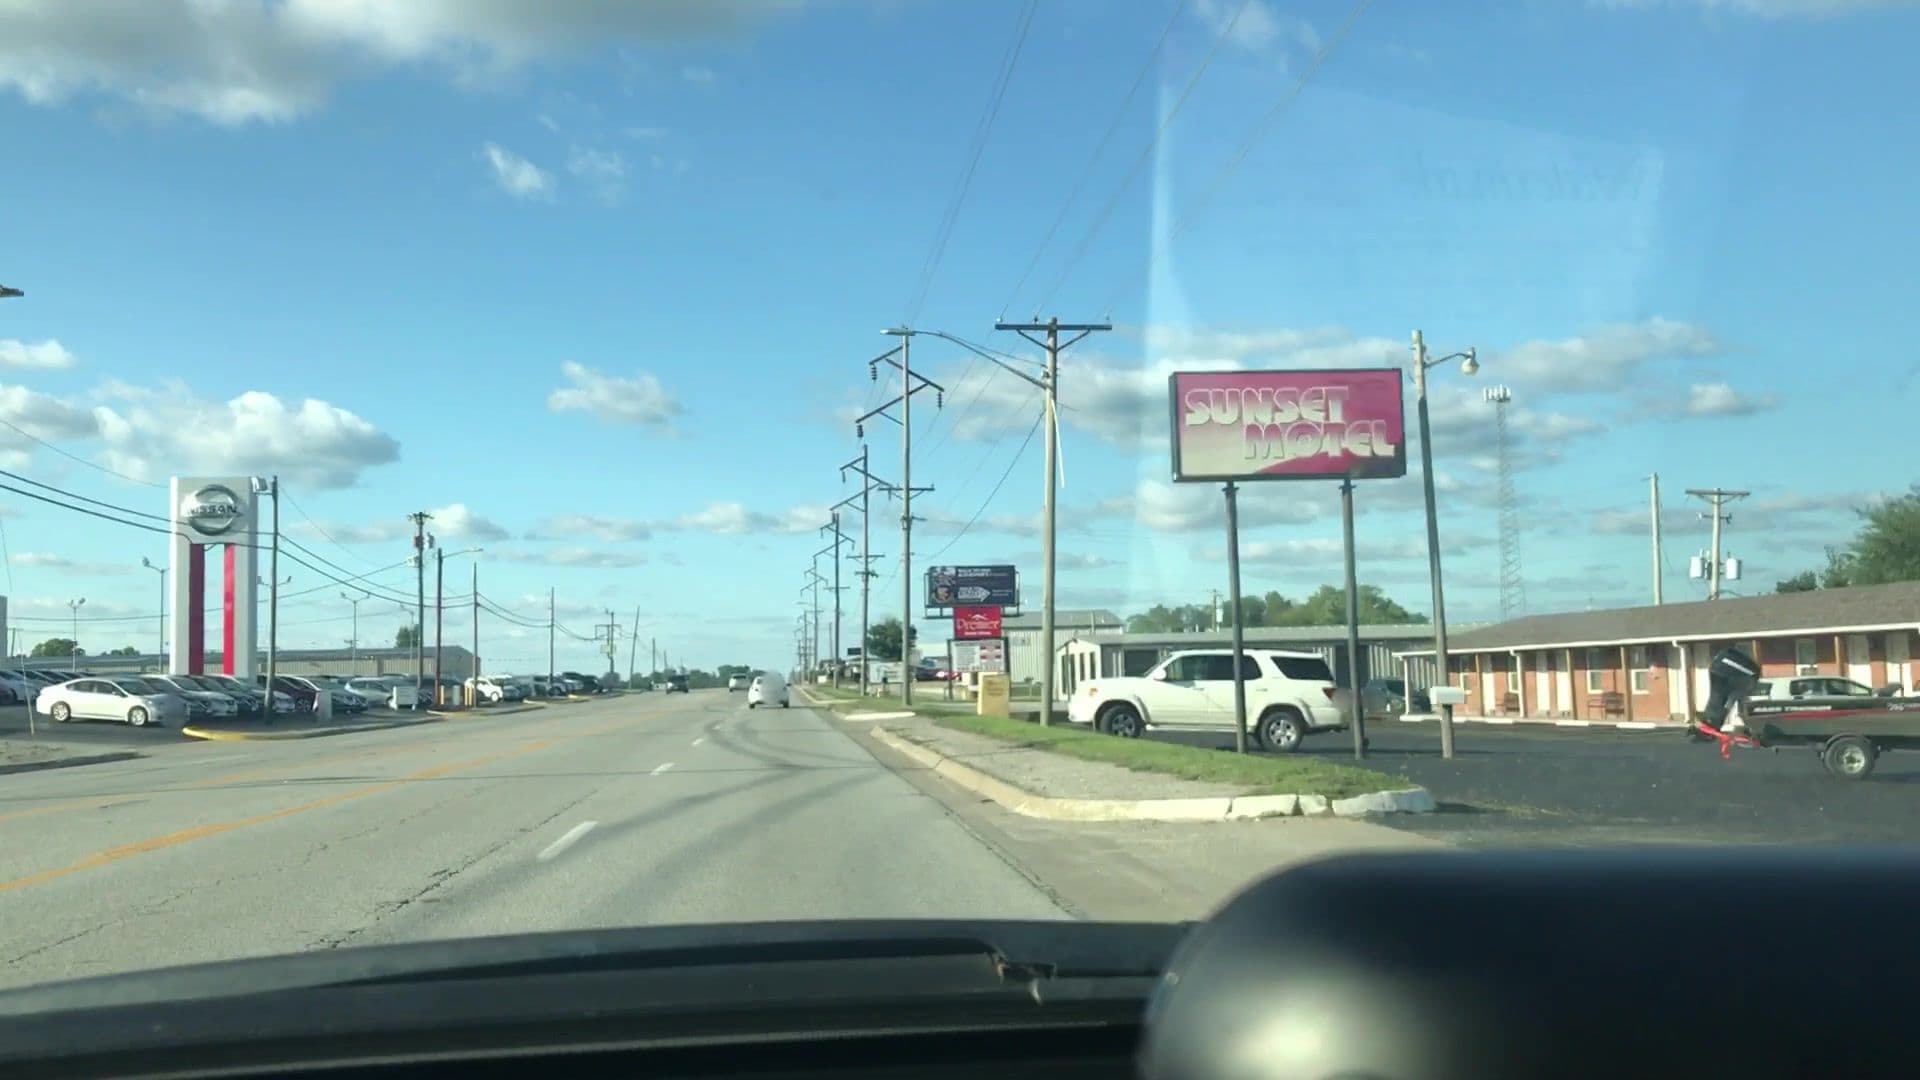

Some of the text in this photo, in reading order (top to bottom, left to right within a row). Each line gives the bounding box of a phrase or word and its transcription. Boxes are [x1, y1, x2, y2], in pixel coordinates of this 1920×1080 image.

[1184, 385, 1349, 426] SUNSET
[1243, 418, 1395, 460] MOTEL
[186, 503, 238, 515] NISSAN
